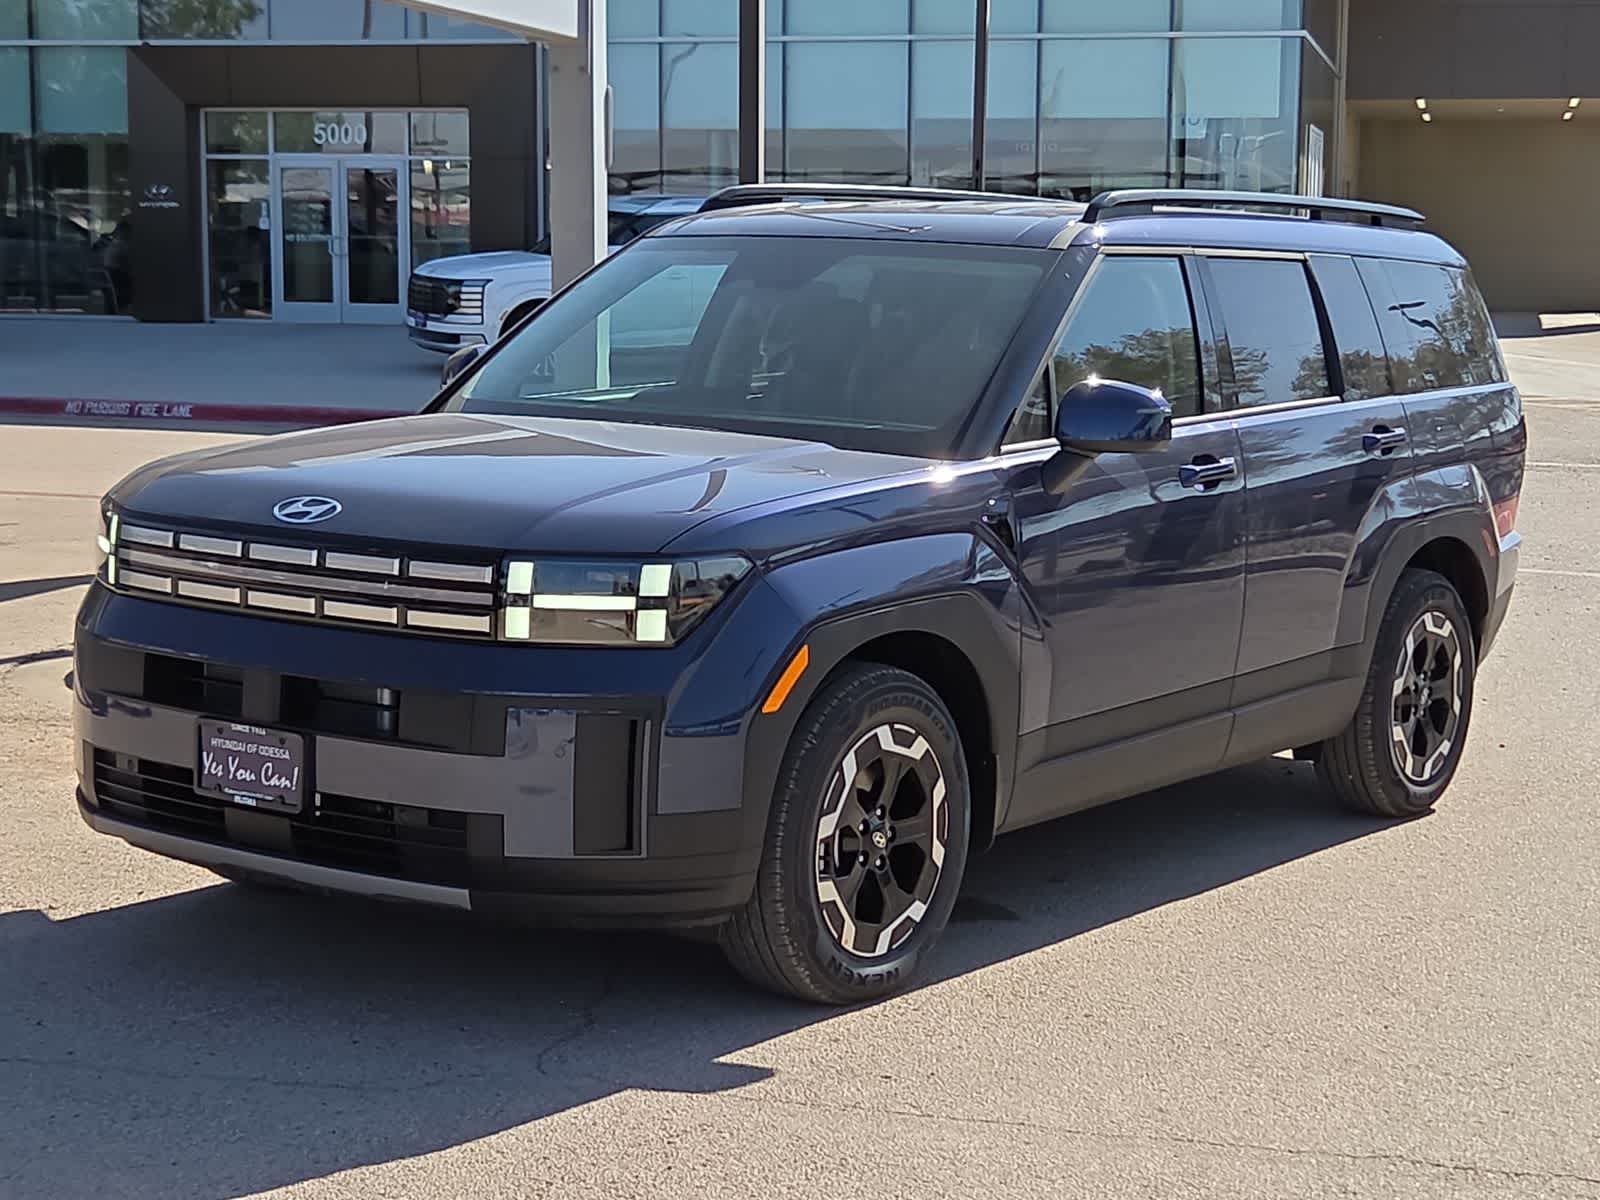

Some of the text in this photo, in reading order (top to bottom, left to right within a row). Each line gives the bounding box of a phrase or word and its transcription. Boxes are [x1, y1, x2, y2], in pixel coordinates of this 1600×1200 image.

[313, 123, 367, 145] 5000
[65, 401, 81, 413] NO
[162, 404, 193, 417] LANE
[247, 743, 258, 754] OF
[258, 745, 290, 760] ODESSA
[202, 751, 299, 791] Yes You Can!
